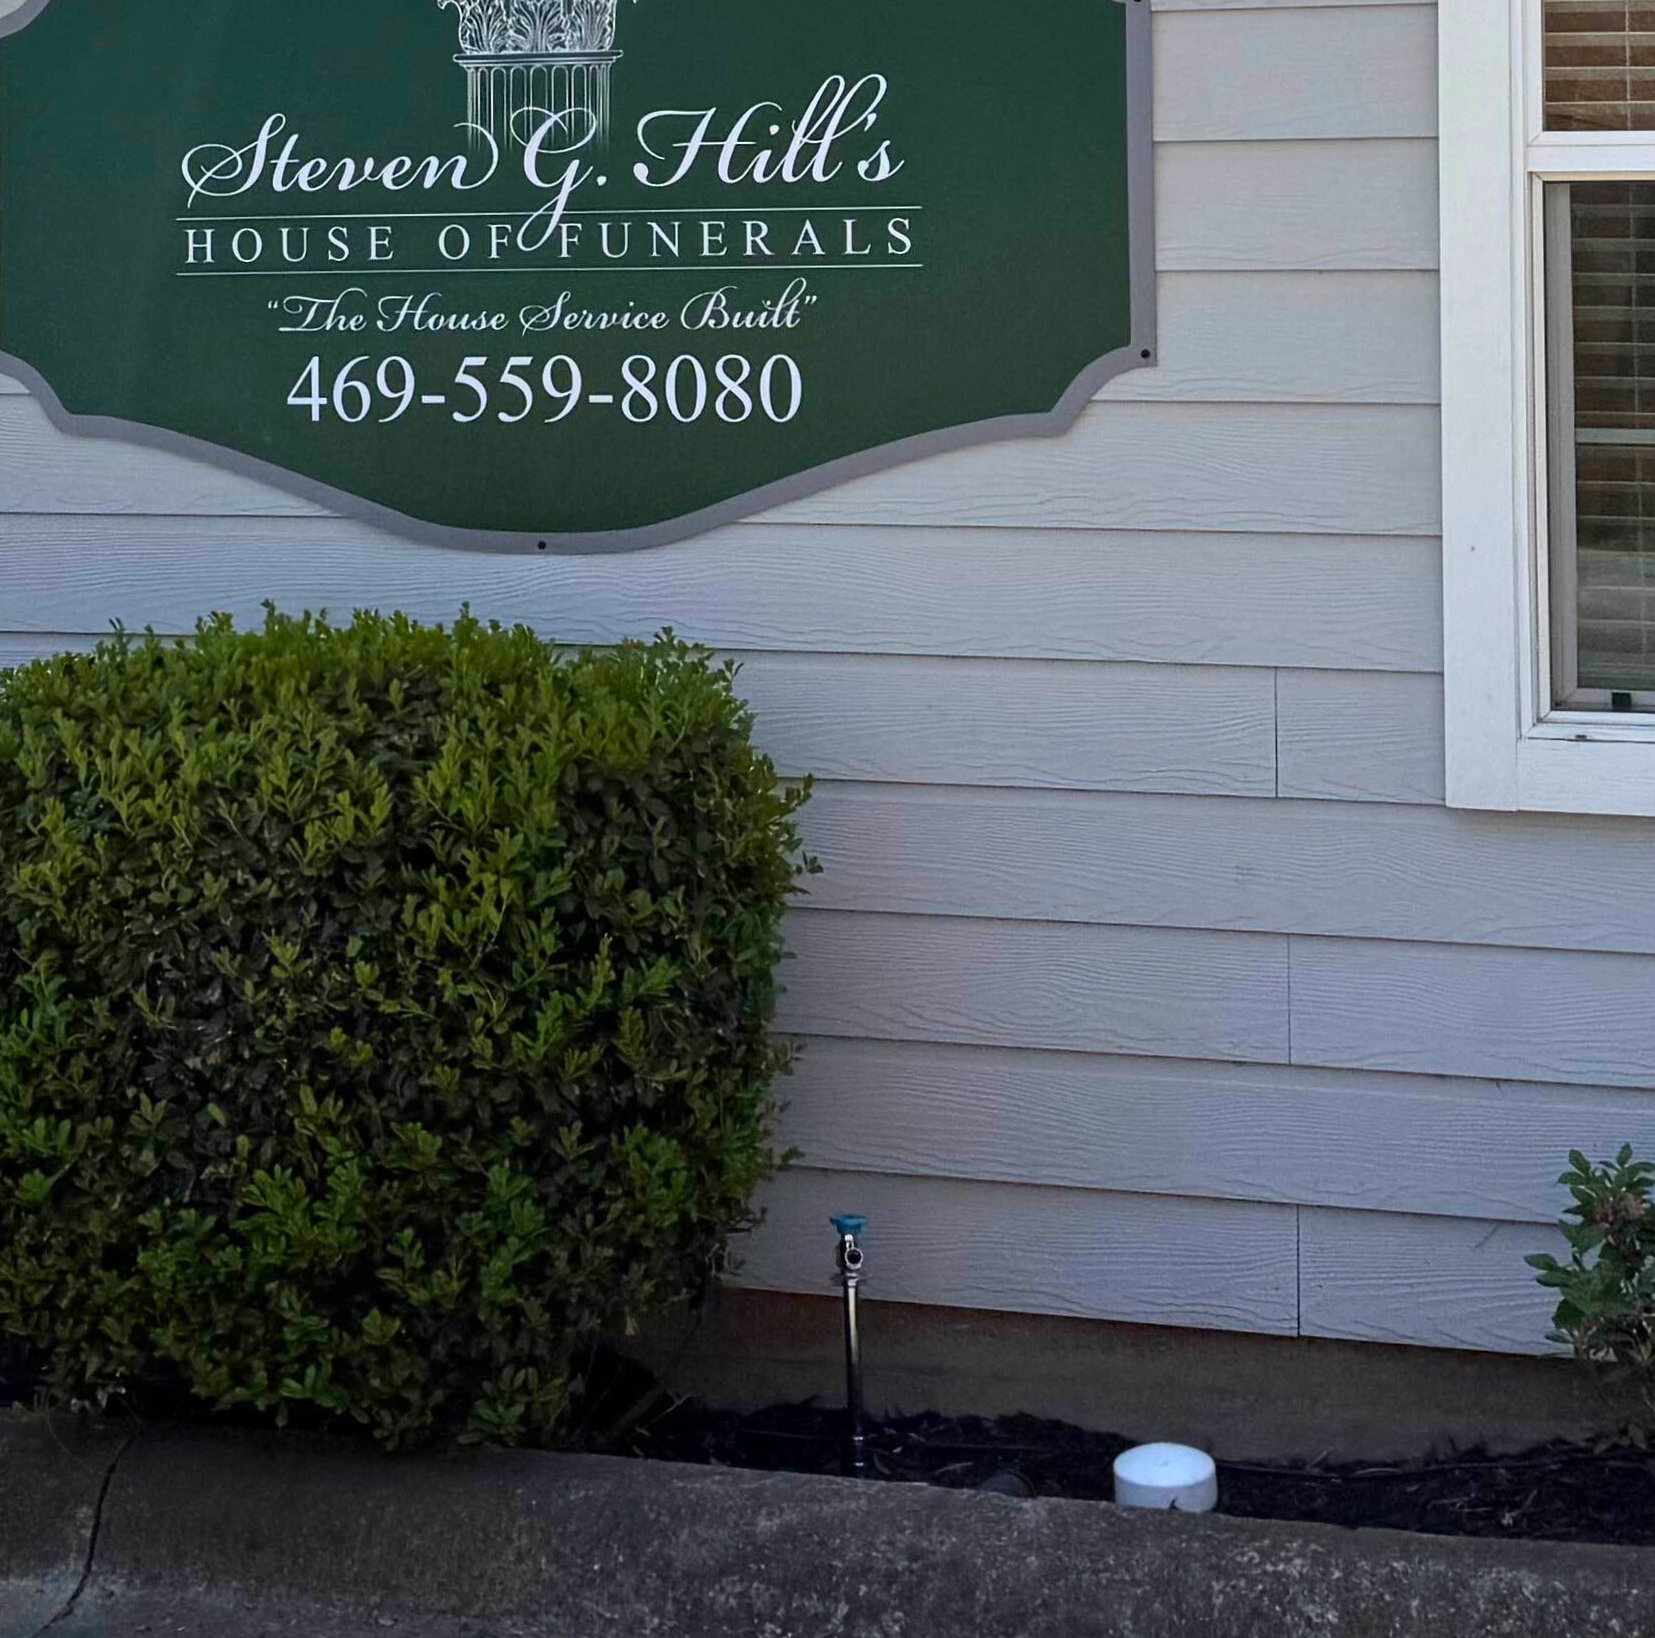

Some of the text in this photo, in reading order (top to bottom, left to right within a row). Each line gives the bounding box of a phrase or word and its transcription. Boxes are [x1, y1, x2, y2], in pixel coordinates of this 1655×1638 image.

[181, 73, 905, 253] Steven G. Hill's
[185, 217, 912, 264] HOUSE OF FUNERALS
[375, 291, 509, 332] House
[518, 291, 670, 336] Service
[286, 353, 803, 424] 469-559-8080
